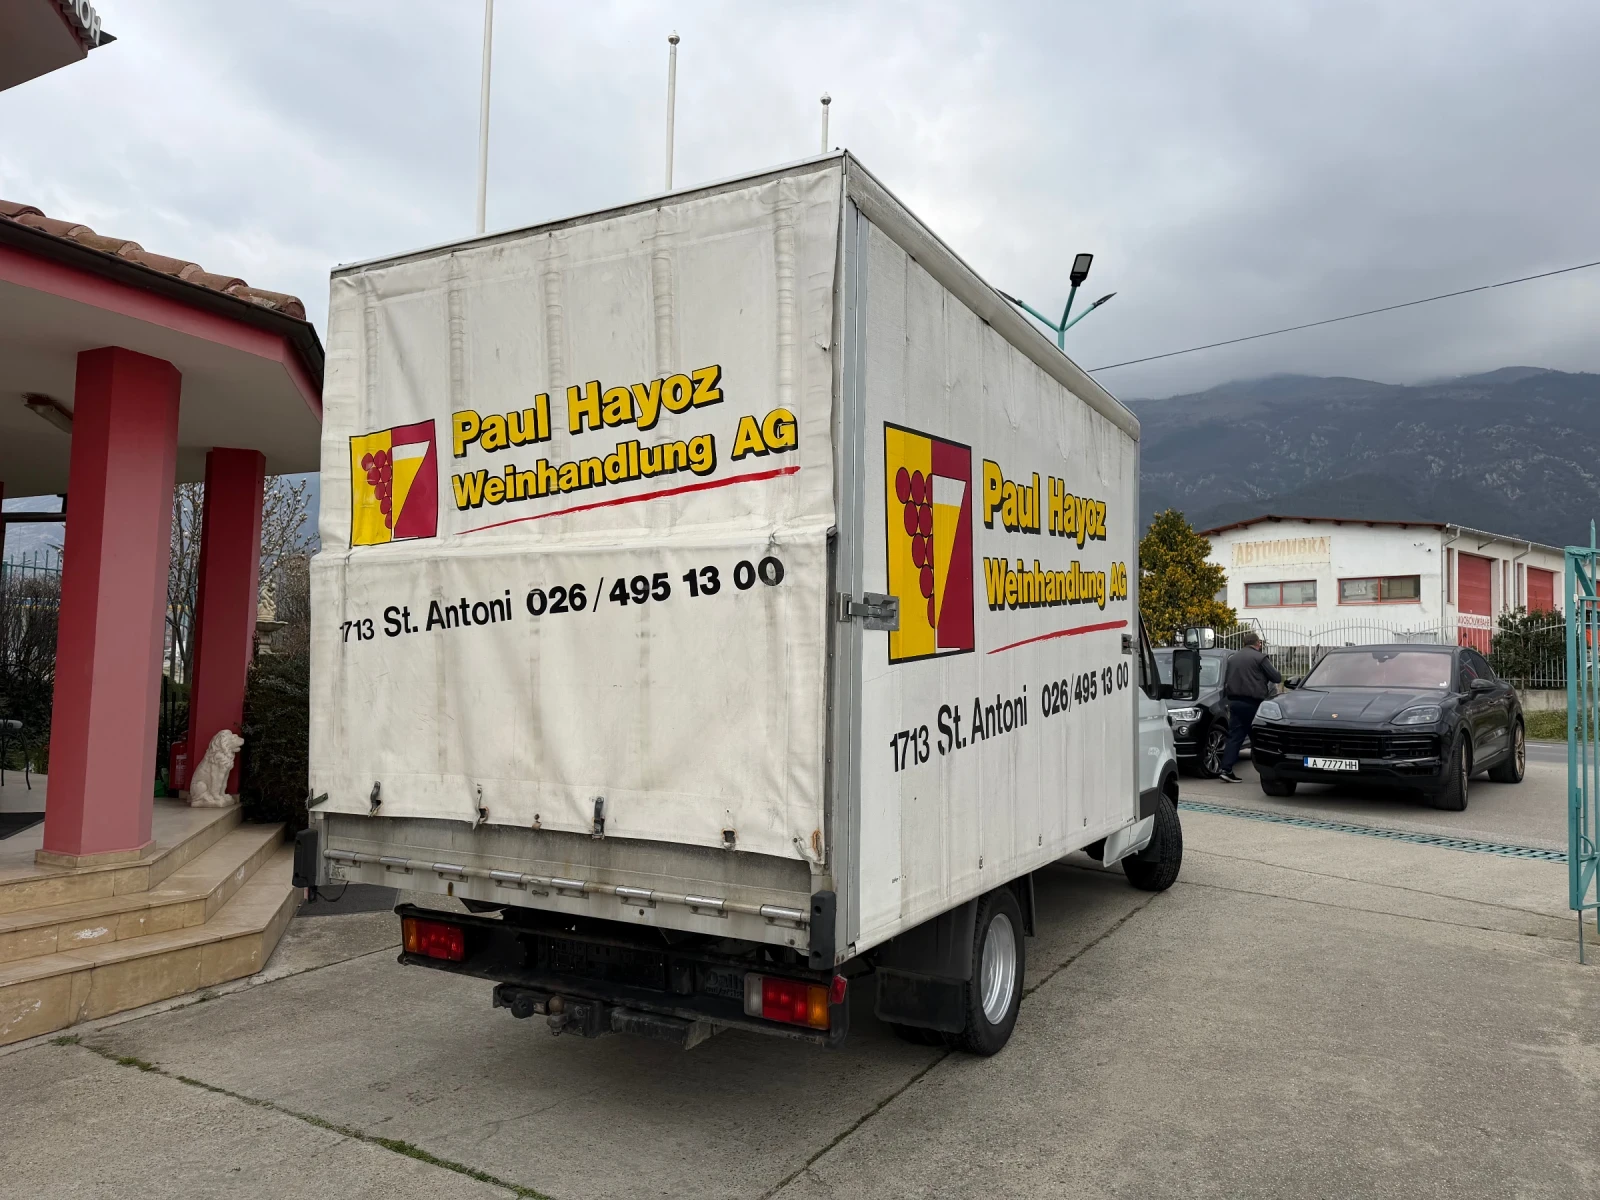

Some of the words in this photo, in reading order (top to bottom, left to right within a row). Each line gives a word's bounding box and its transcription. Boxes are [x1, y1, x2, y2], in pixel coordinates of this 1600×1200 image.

[453, 394, 551, 457] Paul
[566, 364, 724, 435] Hayoz
[452, 434, 718, 511] Weinhandlung
[731, 407, 799, 462] AG
[982, 458, 1041, 535] Paul
[1047, 474, 1107, 549] Hayoz
[384, 606, 419, 638] St.
[425, 590, 513, 632] Antoni
[682, 566, 721, 598] 13
[732, 556, 785, 590] 00
[983, 557, 1106, 611] Weinhandlung
[1109, 561, 1127, 603] AG
[1235, 537, 1327, 566] АВТОМИВКА
[889, 724, 931, 773] 1713
[936, 704, 967, 757] St.
[970, 685, 1028, 744] Antoni
[1100, 665, 1113, 696] 13
[1116, 661, 1129, 689] 00
